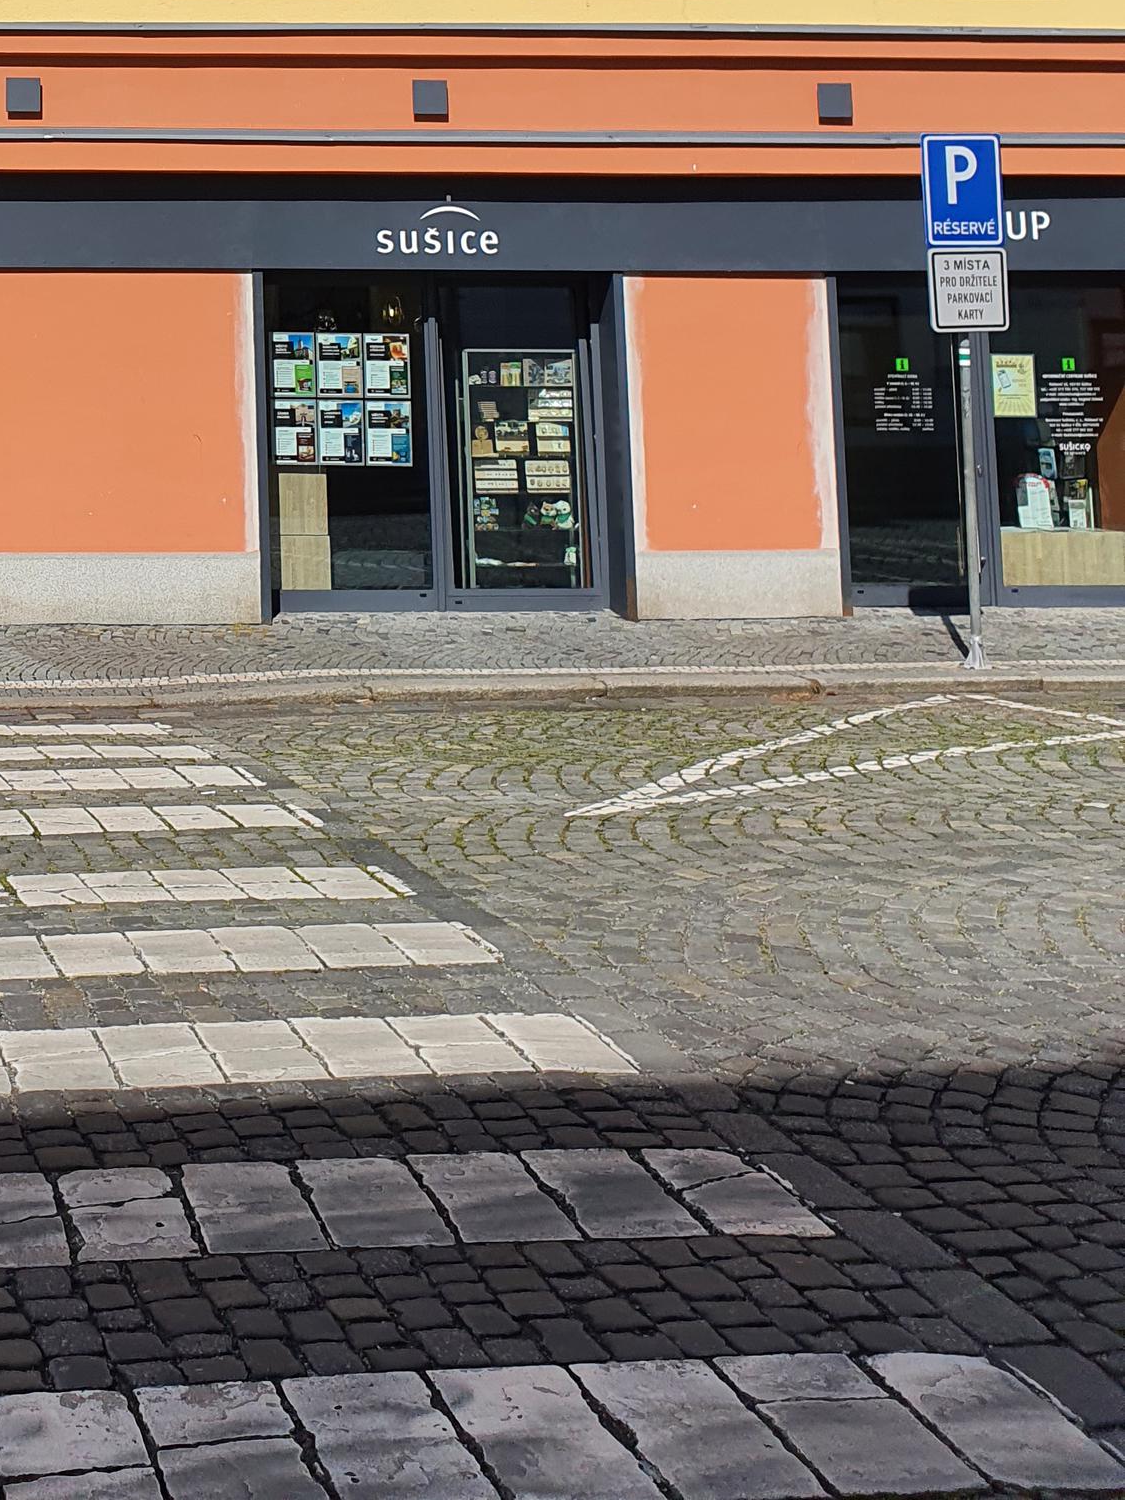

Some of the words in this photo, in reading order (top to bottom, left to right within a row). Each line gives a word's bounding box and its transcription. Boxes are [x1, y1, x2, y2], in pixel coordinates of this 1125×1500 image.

[945, 145, 977, 205] P
[933, 218, 996, 236] RÉSERVÉ
[376, 227, 499, 254] sušice
[943, 260, 950, 271] 3
[953, 256, 991, 271] MÍSTA
[939, 276, 957, 288] PRO
[959, 273, 998, 288] DRŽITELE
[947, 290, 993, 304] PARKOVACÍ
[957, 309, 984, 321] KARTY
